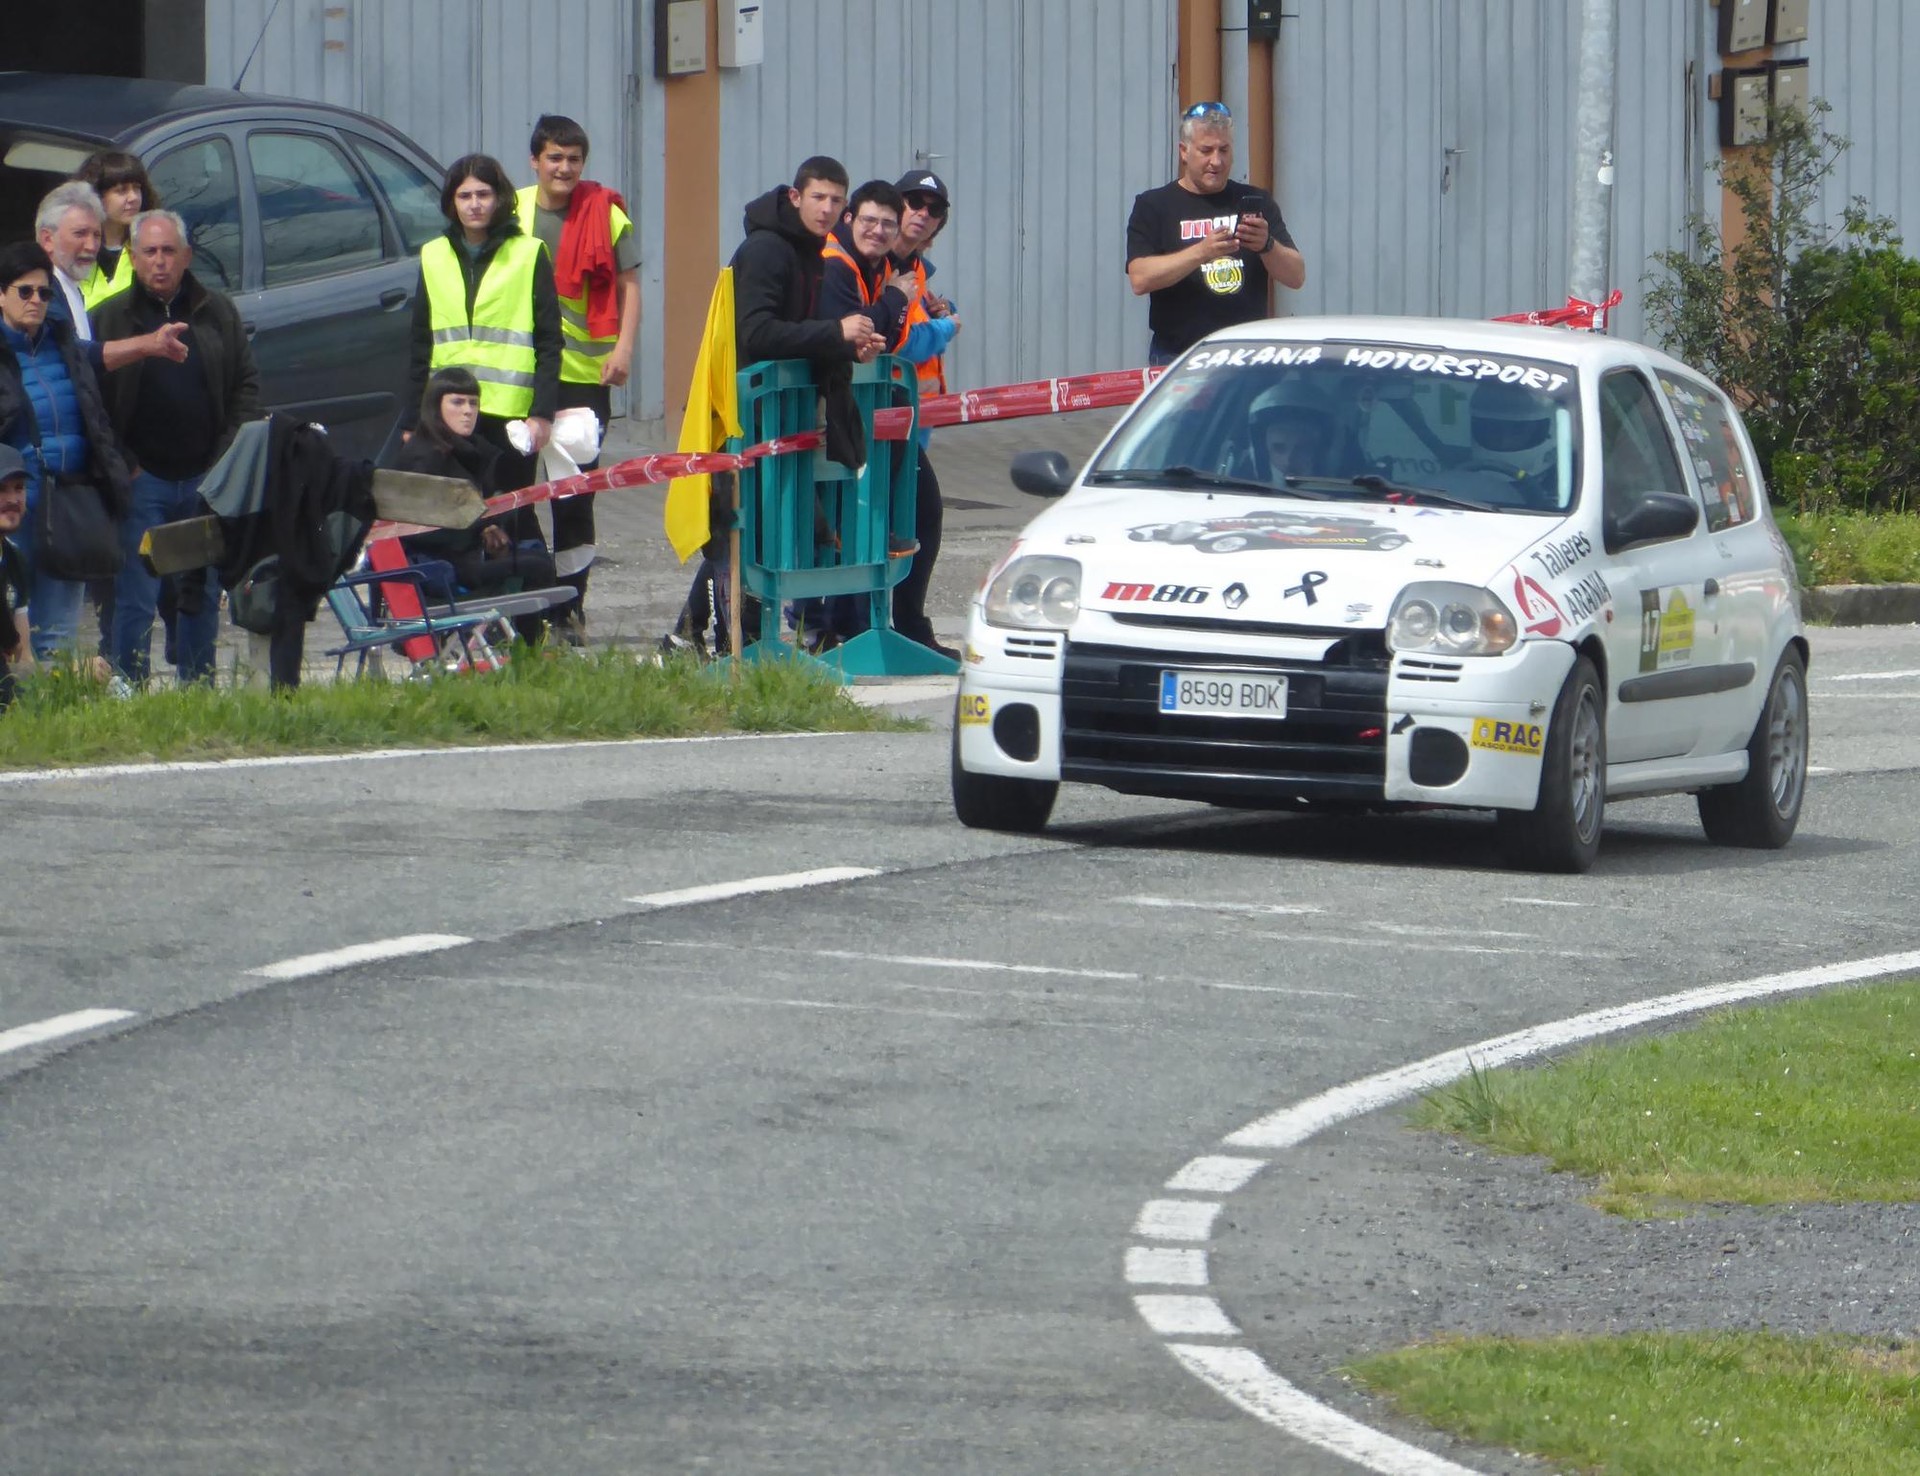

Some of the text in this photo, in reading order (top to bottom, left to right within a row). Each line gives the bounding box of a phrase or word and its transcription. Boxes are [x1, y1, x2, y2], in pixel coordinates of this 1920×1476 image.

[1186, 346, 1568, 392] SAKANA MOTORSPORT
[1531, 531, 1591, 579] Talleres
[1180, 680, 1280, 709] 8599 BDK
[1494, 721, 1541, 748] RAC
